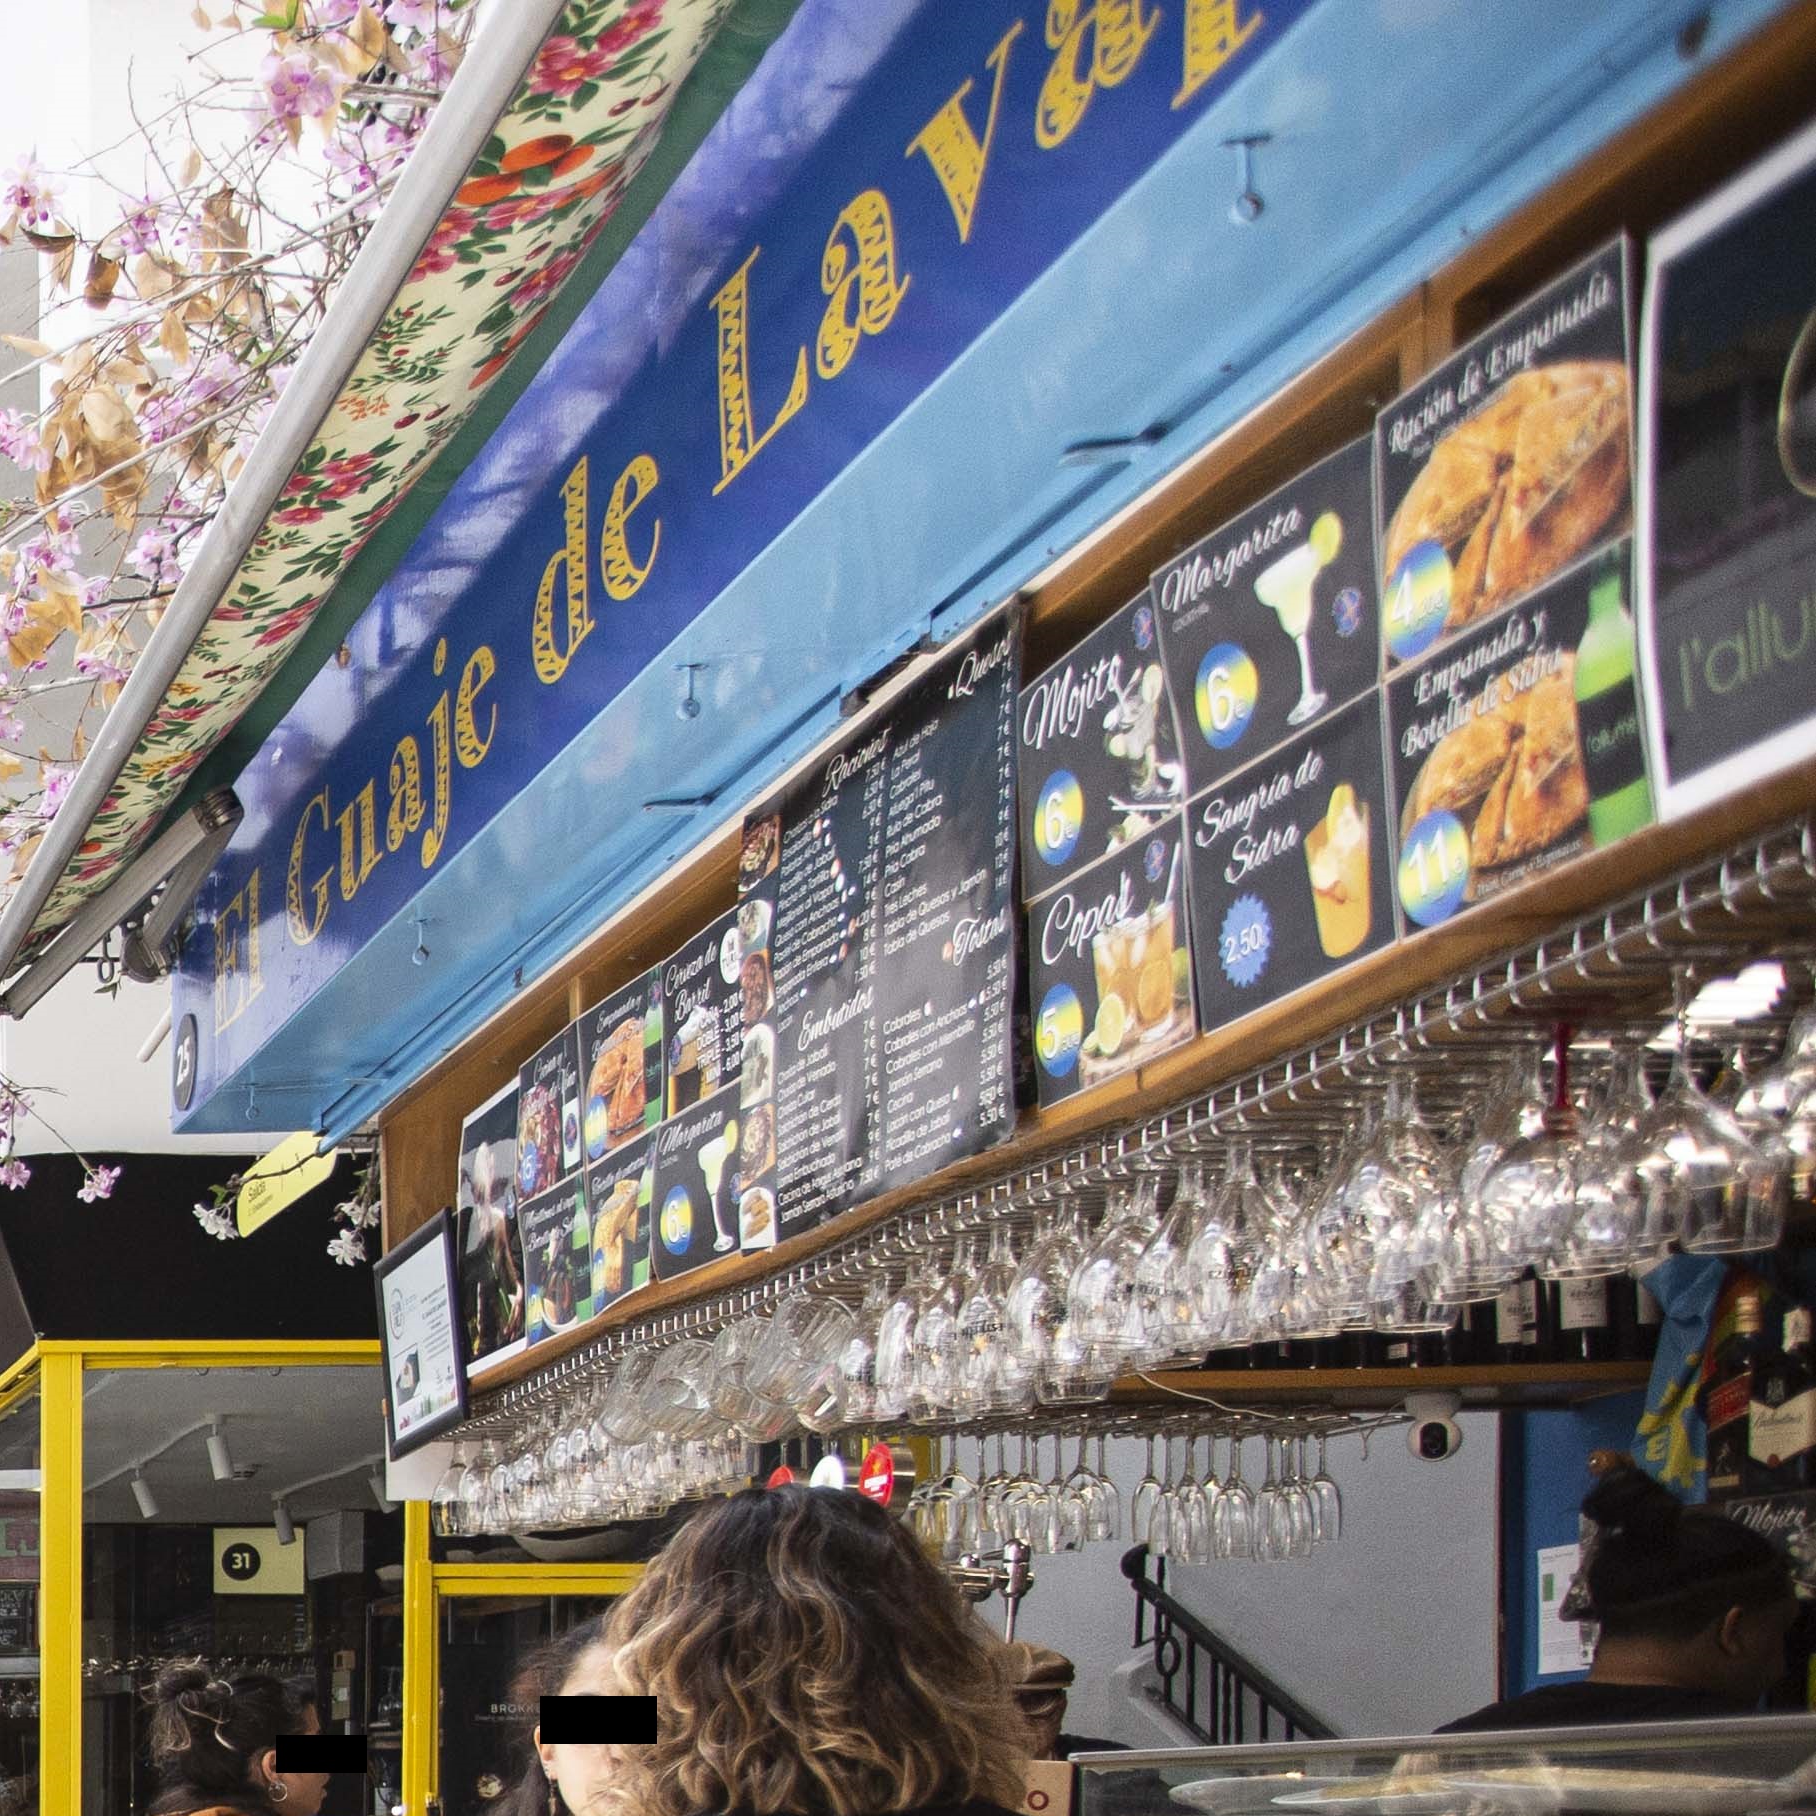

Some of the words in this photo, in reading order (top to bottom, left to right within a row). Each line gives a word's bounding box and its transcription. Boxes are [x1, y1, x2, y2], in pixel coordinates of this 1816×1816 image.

[1389, 387, 1455, 454] Ración
[1458, 359, 1486, 404] de
[1485, 271, 1611, 382] Empanada
[1162, 507, 1302, 612] Margarita
[1391, 570, 1415, 627] 4
[956, 631, 1012, 698] Quesos
[1413, 613, 1528, 705] Empanada
[1530, 609, 1549, 645] y
[1023, 654, 1122, 750] Mojito
[1401, 694, 1475, 758] Botella
[1476, 675, 1503, 716] de
[1504, 644, 1563, 703] Sidra
[214, 868, 263, 1036] El
[286, 638, 497, 946] Guaje
[531, 455, 660, 683] de
[889, 769, 922, 799] Cabrales
[915, 795, 943, 819] Cabra
[1196, 773, 1293, 847] Sangría
[1295, 749, 1324, 789] de
[902, 815, 942, 848] Ahumado
[1224, 823, 1300, 884] Sidra
[900, 845, 926, 869] Cabra
[884, 917, 905, 937] Tabla
[919, 890, 950, 917] Quesos
[958, 868, 987, 896] Jamón
[899, 883, 928, 909] Leches
[1042, 870, 1135, 966] Copas
[801, 916, 837, 945] Cabracho
[884, 936, 905, 957] Tabla
[919, 911, 951, 937] Quesos
[953, 908, 1005, 966] Tostas
[665, 953, 704, 997] Cerveza
[704, 941, 717, 963] de
[675, 977, 712, 1023] Barril
[797, 986, 874, 1051] Embutidos
[883, 1008, 921, 1034] Cabrales
[884, 1029, 919, 1054] Cabrales
[920, 1023, 935, 1037] con
[936, 1004, 967, 1030] Anchoas
[886, 1048, 921, 1074] Cabrales
[922, 1042, 937, 1057] con
[938, 1018, 976, 1048] Membrillo
[1041, 1008, 1060, 1059] 5
[176, 1037, 192, 1087] 25
[887, 1072, 913, 1094] Jamón
[914, 1058, 944, 1080] Serrano
[886, 1113, 909, 1134] Lacón
[926, 1094, 951, 1114] Queso
[887, 1091, 914, 1113] Cecina
[659, 1108, 723, 1156] Margarita
[886, 1129, 916, 1153] Picadillo
[928, 1109, 952, 1133] Jabalí
[914, 1132, 952, 1158] Cabracho
[231, 1553, 251, 1570] 31
